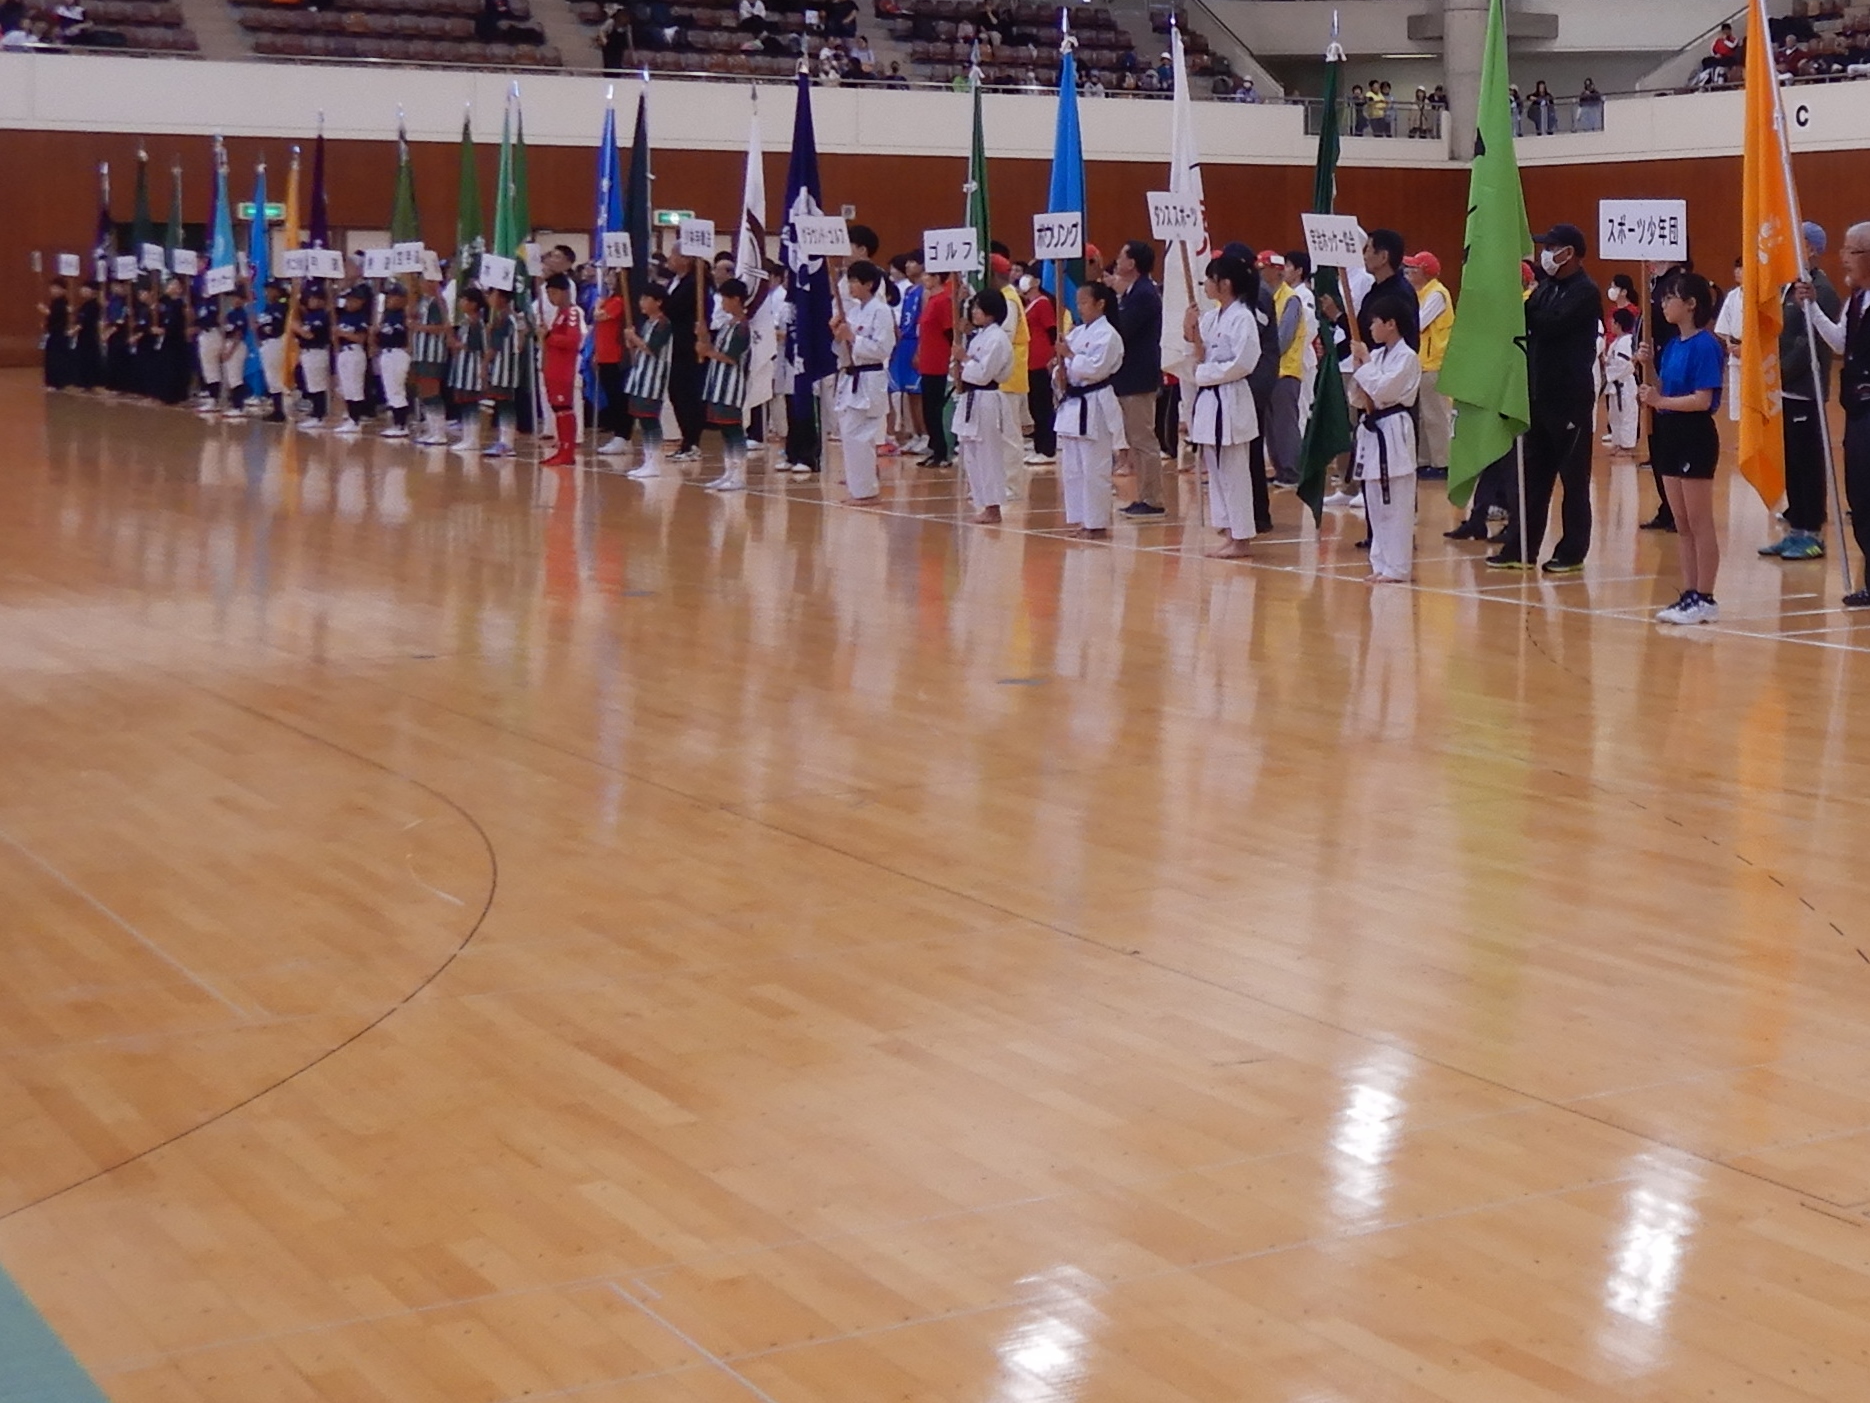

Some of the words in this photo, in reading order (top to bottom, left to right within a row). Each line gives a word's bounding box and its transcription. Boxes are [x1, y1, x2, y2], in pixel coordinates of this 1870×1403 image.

[1796, 104, 1809, 128] C
[1037, 221, 1079, 249] ボウリング
[1607, 214, 1679, 247] スポーツ少年団
[928, 241, 973, 262] ゴルフ
